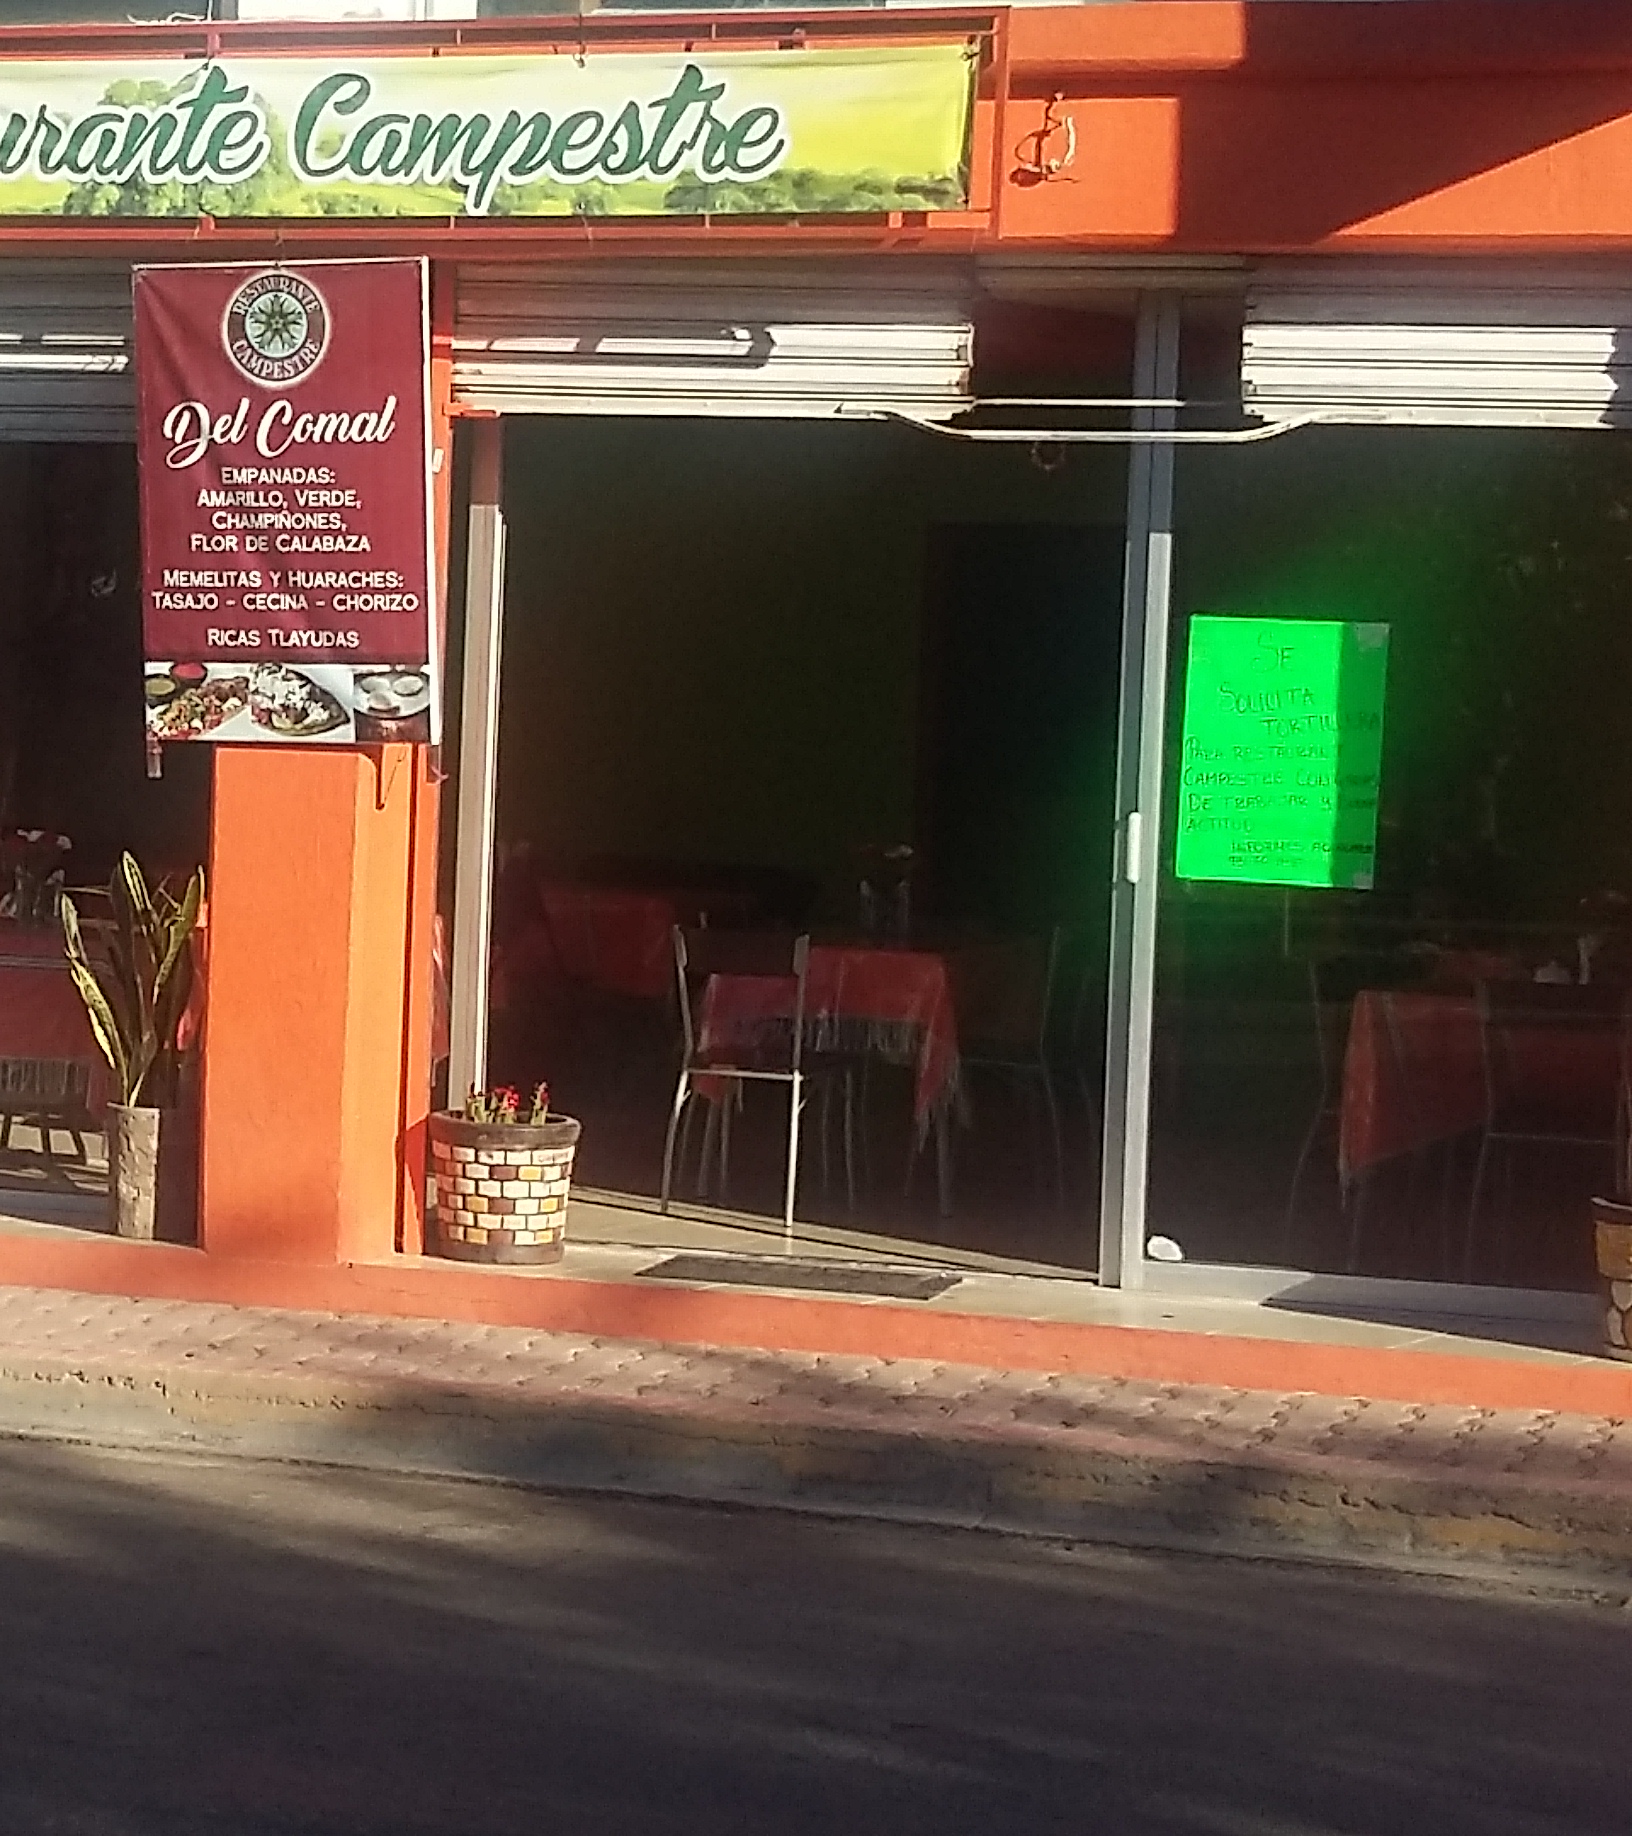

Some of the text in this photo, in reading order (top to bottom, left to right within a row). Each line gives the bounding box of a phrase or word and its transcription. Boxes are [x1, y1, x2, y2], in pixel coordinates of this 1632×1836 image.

[293, 62, 786, 209] Campestre
[232, 277, 321, 316] RESTAURANTE
[232, 339, 321, 379] CAMPESTRE
[162, 395, 397, 469] Del Comal
[221, 467, 336, 485] EMPANADAS:
[196, 488, 362, 510] AMARILLO, VERDE,
[211, 510, 348, 532] CHAMPIÑONES,
[190, 533, 371, 553] FLOR DE CALABAZA
[163, 568, 404, 589] MEMELITAS Y HUARACHES:
[151, 591, 219, 610] TASAJO
[242, 593, 309, 610] CECINA
[332, 593, 419, 611] CHORIZO
[207, 628, 360, 648] RICAS TLAYUDAS
